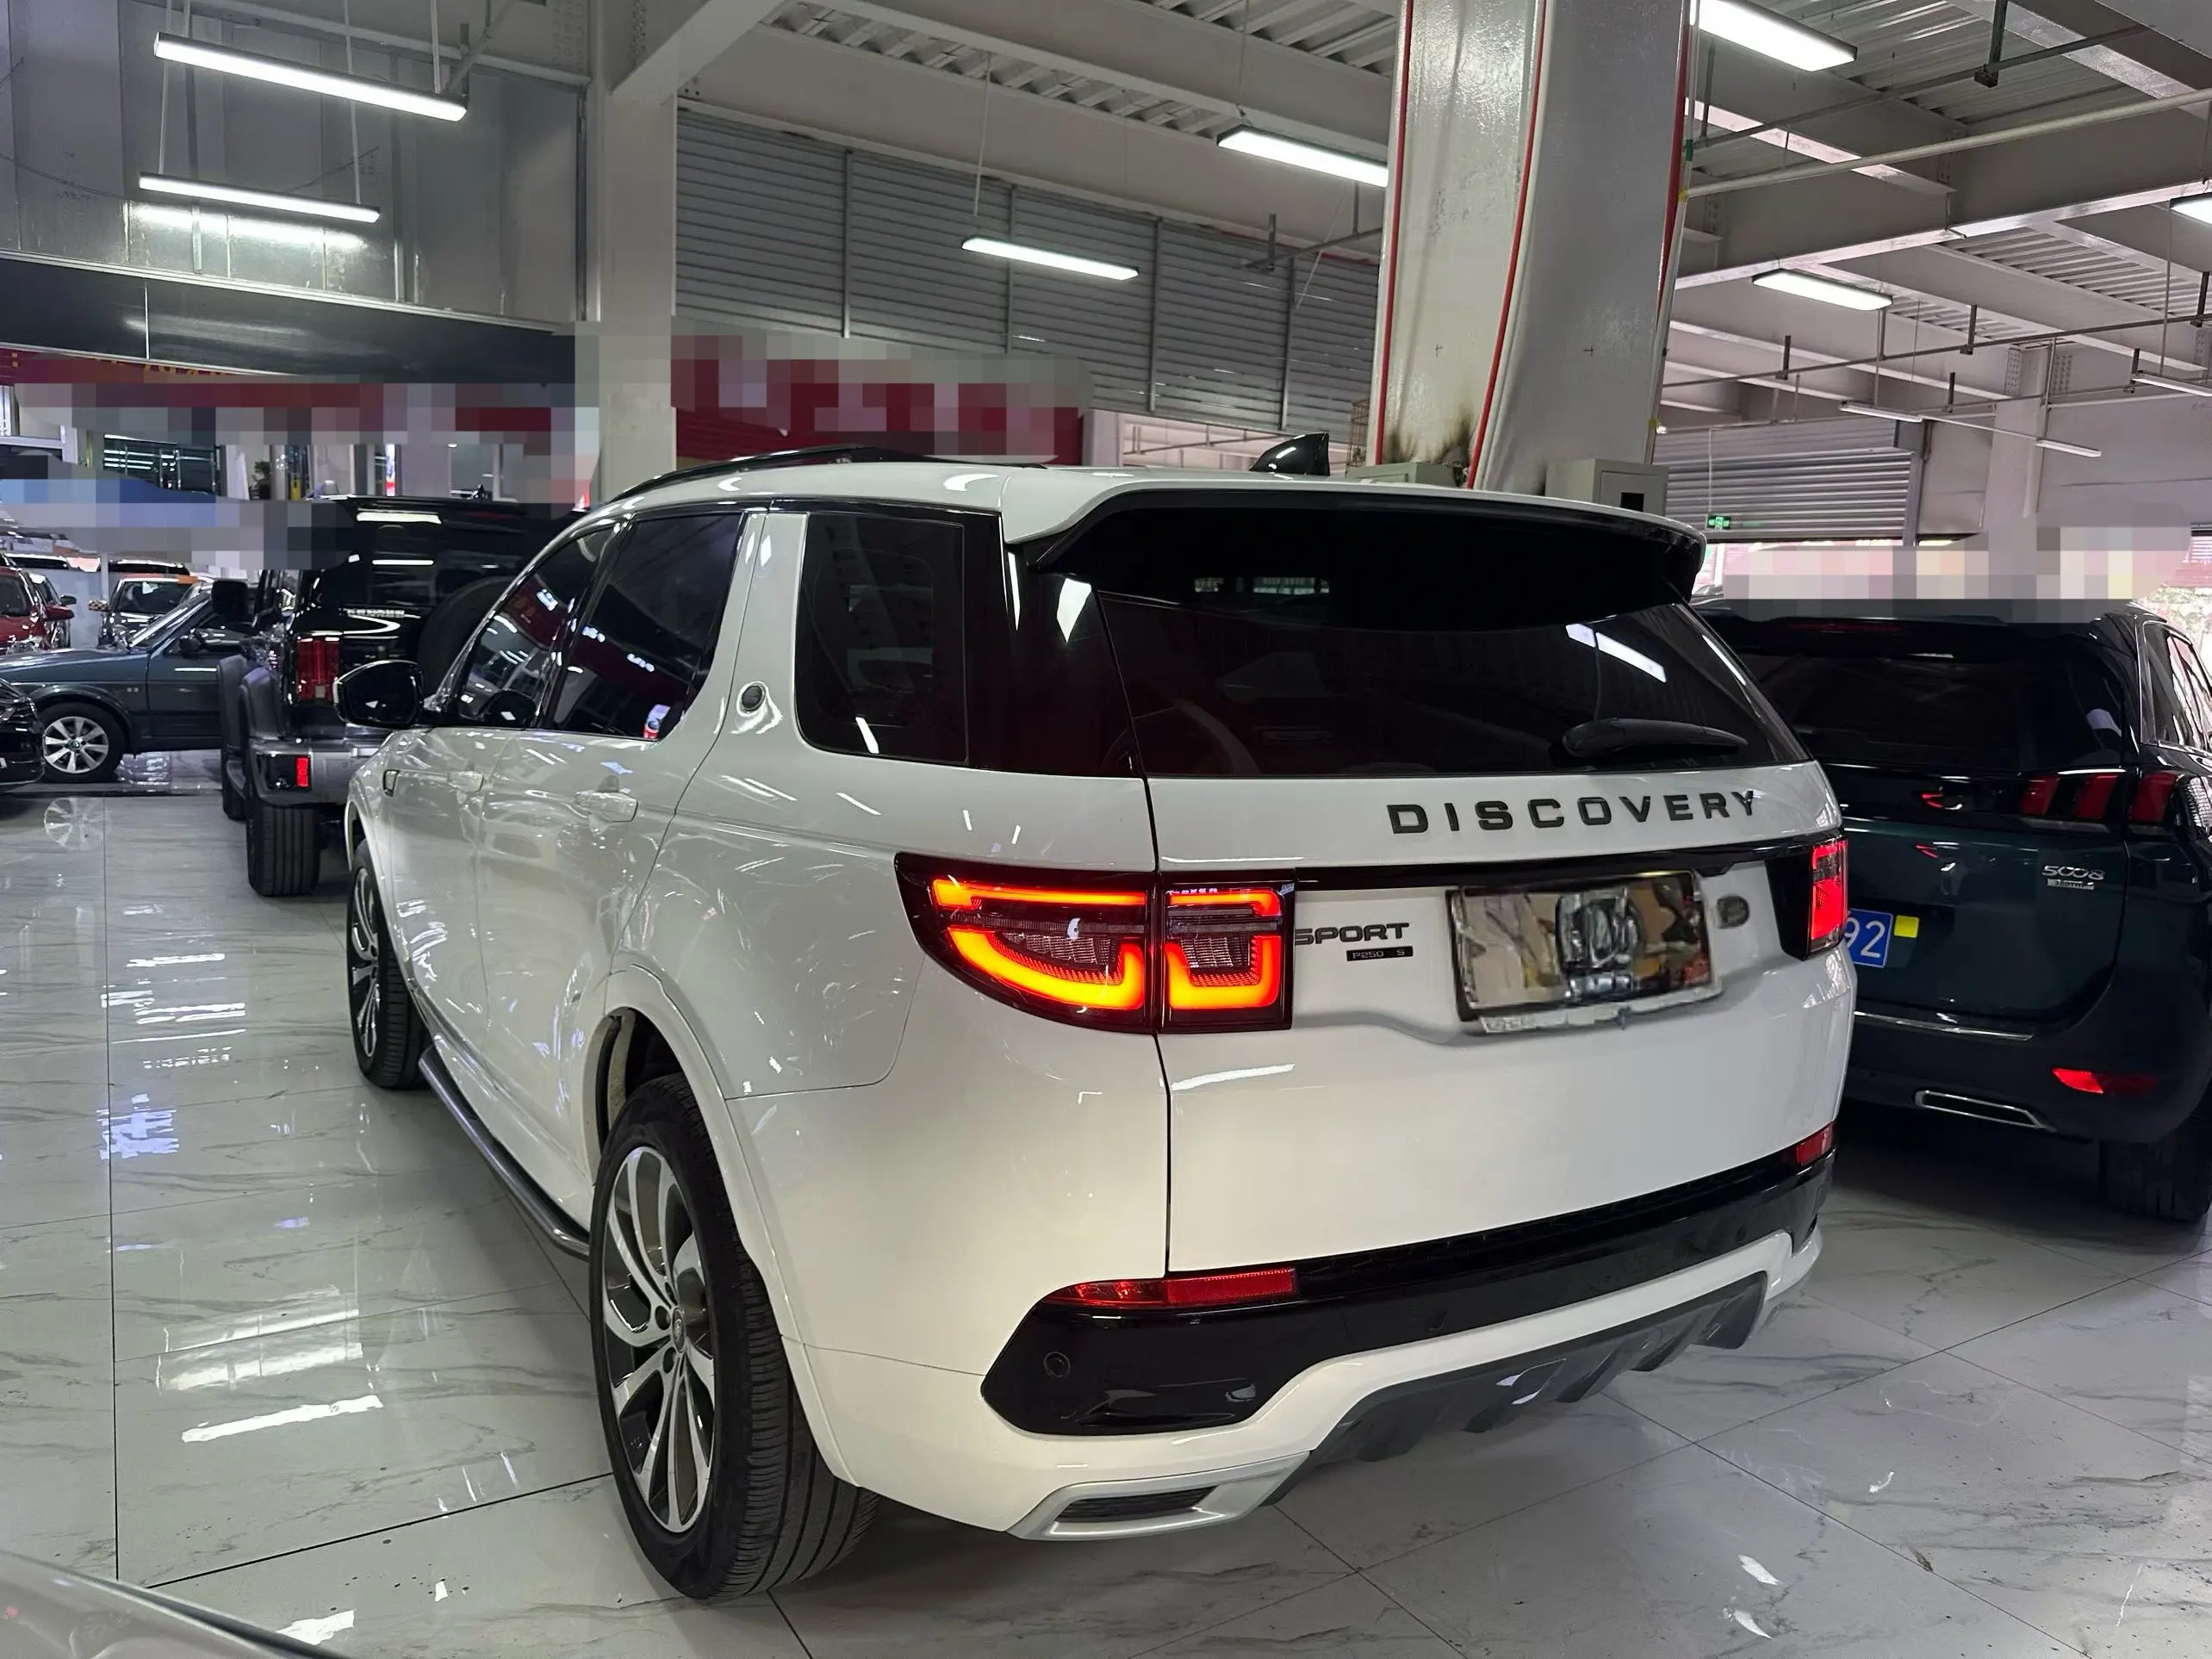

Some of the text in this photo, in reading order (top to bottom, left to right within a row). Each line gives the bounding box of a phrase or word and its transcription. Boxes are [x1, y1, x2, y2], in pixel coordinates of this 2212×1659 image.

[1387, 790, 1755, 835] DISCOVERY
[2042, 865, 2105, 881] 5008
[1295, 923, 1410, 947] SPORT
[1844, 916, 1886, 959] 92
[1352, 950, 1384, 960] P250
